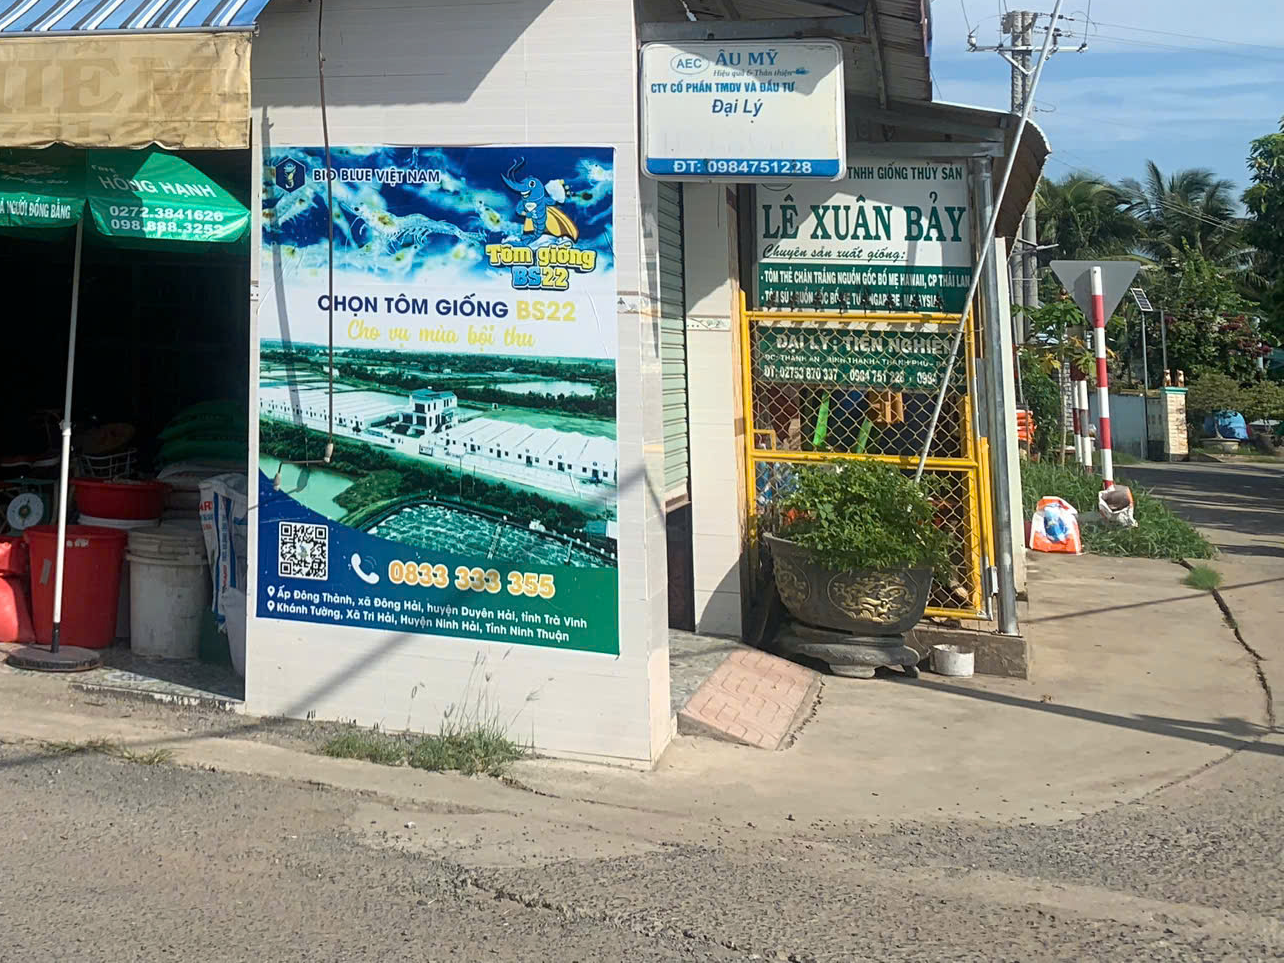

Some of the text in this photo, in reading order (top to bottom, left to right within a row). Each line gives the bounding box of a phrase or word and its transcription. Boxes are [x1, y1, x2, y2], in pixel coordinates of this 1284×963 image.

[676, 58, 702, 69] AEC
[716, 48, 779, 66] ÂU MỸ
[651, 83, 667, 93] CTY
[715, 82, 741, 93] TMDV
[745, 79, 757, 93] VÀ
[782, 80, 795, 93] TƯ
[712, 98, 764, 116] Đại Lý
[673, 160, 812, 174] ĐT: 0984751228
[847, 161, 963, 180] TNHH GIỐNG THỦY SẢN
[313, 168, 441, 186] BIO BLUE VIỆT NAM
[159, 181, 217, 199] HẠNH
[762, 191, 966, 242] LÊ XUÂN BẢY
[486, 241, 598, 272] Tôm giống
[763, 244, 807, 260] Chuyên
[810, 247, 832, 259] sản
[836, 244, 864, 259] xuất
[512, 266, 571, 290] BS22
[764, 269, 779, 284] TÔM
[793, 268, 812, 285] CHÂN
[862, 267, 877, 286] GỐC
[878, 267, 888, 286] BỐ
[888, 273, 899, 289] MẸ
[927, 274, 938, 287] CP
[956, 274, 972, 288] LAN
[317, 292, 577, 322] CHỌN TÔM GIỐNG BS22
[348, 318, 381, 341] Cho
[388, 326, 411, 348] vụ
[419, 323, 459, 345] mùa
[504, 326, 536, 347] thu
[823, 368, 838, 381] 337
[388, 559, 557, 600] 0833 333 355
[277, 586, 291, 601] Ấp
[293, 590, 320, 606] Đông
[322, 591, 356, 608] Thành,
[357, 595, 371, 606] xã
[373, 597, 400, 612] Đông
[427, 601, 458, 617] huyện
[461, 605, 495, 620] Duyên
[544, 611, 561, 626] Trà
[563, 615, 588, 629] Vinh
[276, 601, 308, 615] Khánh
[345, 607, 361, 620] Xã
[400, 613, 433, 630] Huyện
[435, 616, 459, 630] Ninh
[509, 624, 534, 638] Ninh
[536, 625, 569, 642] Thuận
